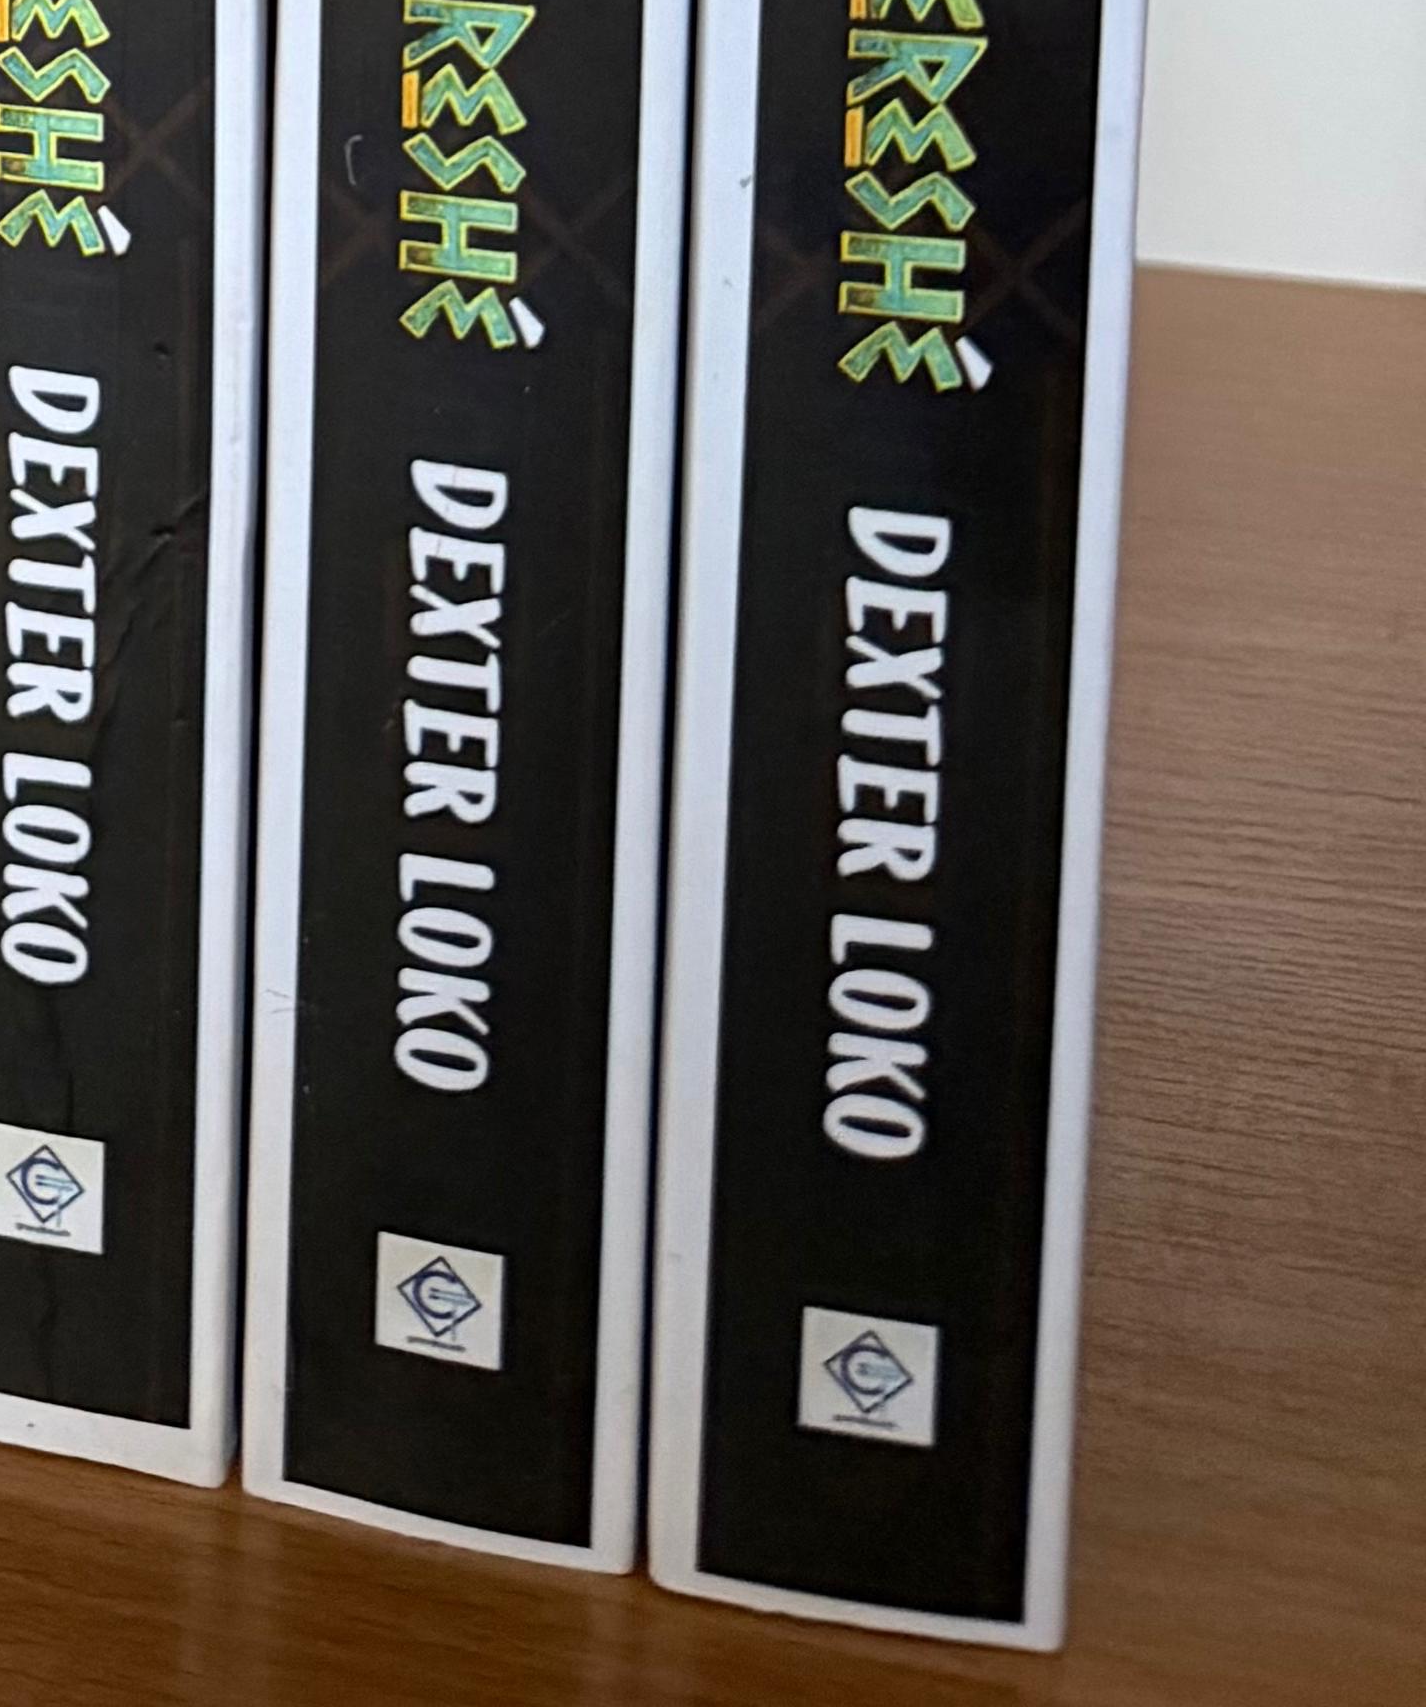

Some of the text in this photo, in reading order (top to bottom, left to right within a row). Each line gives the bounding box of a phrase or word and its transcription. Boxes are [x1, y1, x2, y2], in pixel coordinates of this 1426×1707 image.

[1, 366, 100, 983] DEXTER LOKO
[395, 460, 507, 1090] DEXTER LOKO
[825, 507, 950, 1157] DEXTER LOKO
